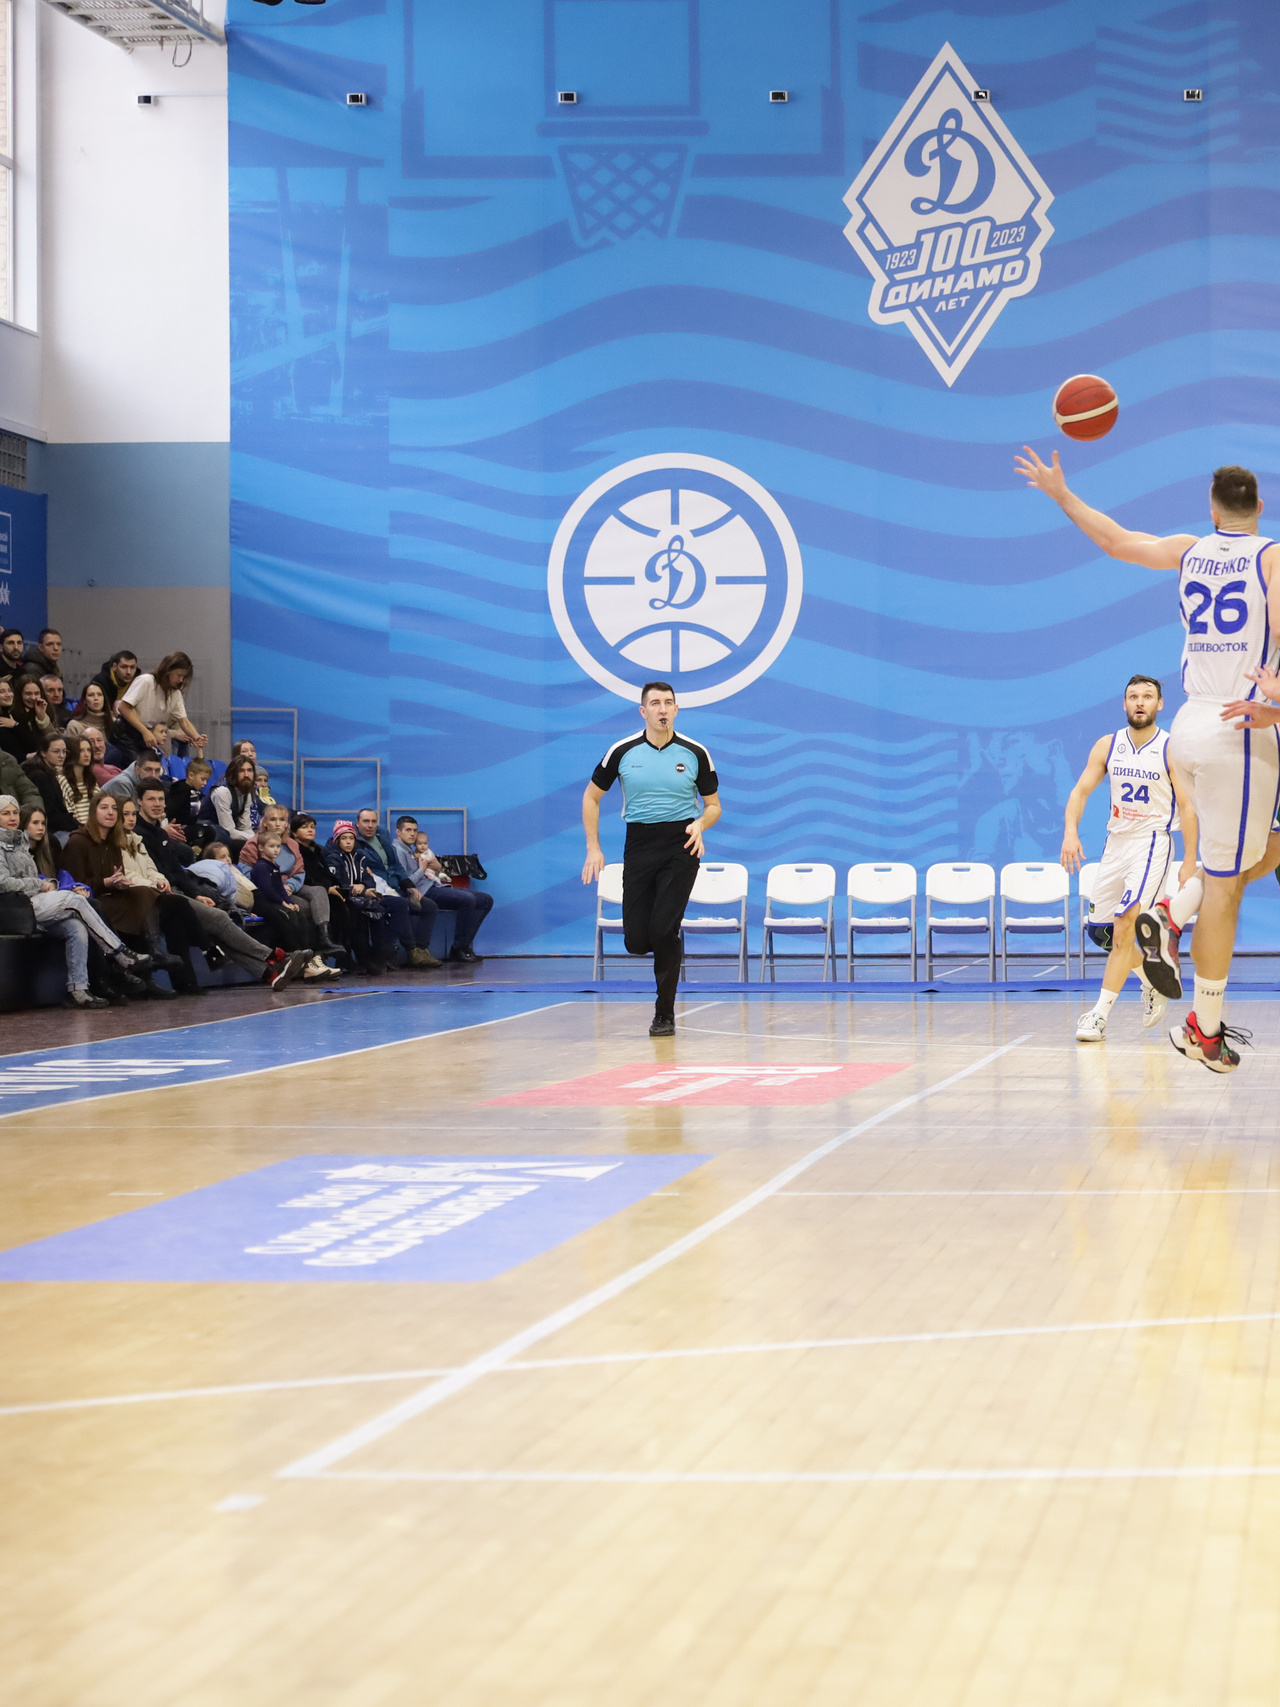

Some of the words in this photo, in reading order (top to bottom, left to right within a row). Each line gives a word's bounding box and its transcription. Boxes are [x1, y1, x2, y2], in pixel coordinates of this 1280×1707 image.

[885, 249, 917, 272] 1923
[917, 220, 993, 279] 100
[990, 226, 1027, 249] 2023
[884, 260, 1025, 309] ДИНАМО
[935, 296, 970, 313] ЛЕТ
[1184, 580, 1249, 634] 26
[1113, 766, 1160, 781] ДИНАМО
[1121, 782, 1150, 804] 24
